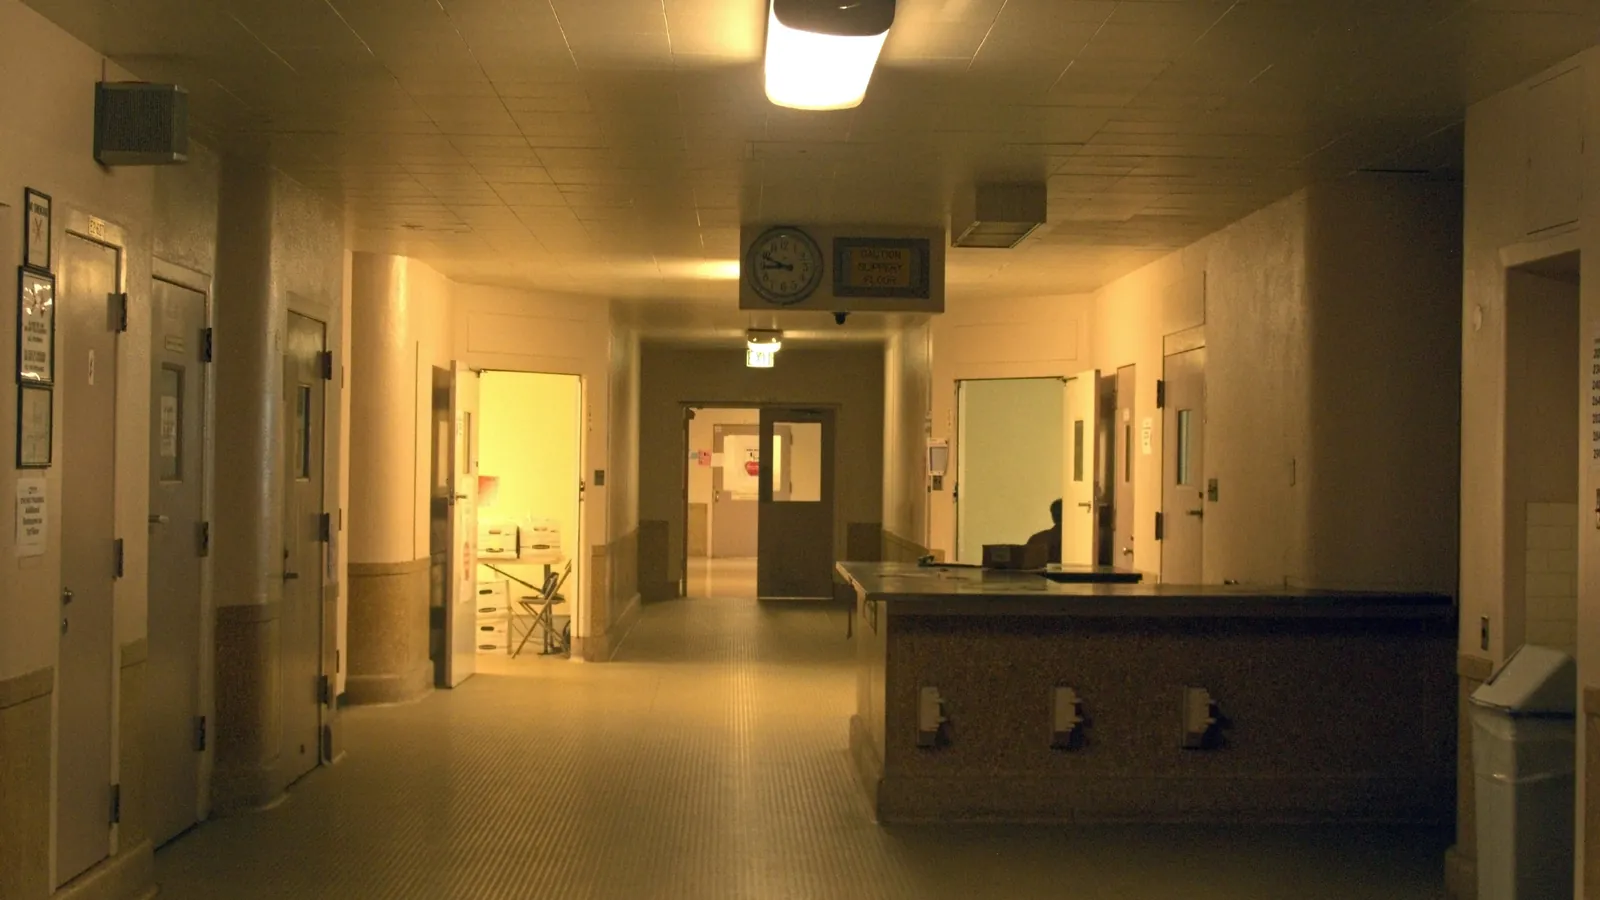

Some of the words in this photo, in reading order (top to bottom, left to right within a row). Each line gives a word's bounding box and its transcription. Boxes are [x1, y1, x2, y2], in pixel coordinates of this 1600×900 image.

[860, 248, 902, 260] CAUTION
[858, 262, 903, 274] SLIPPERY
[863, 275, 897, 285] FLOOR
